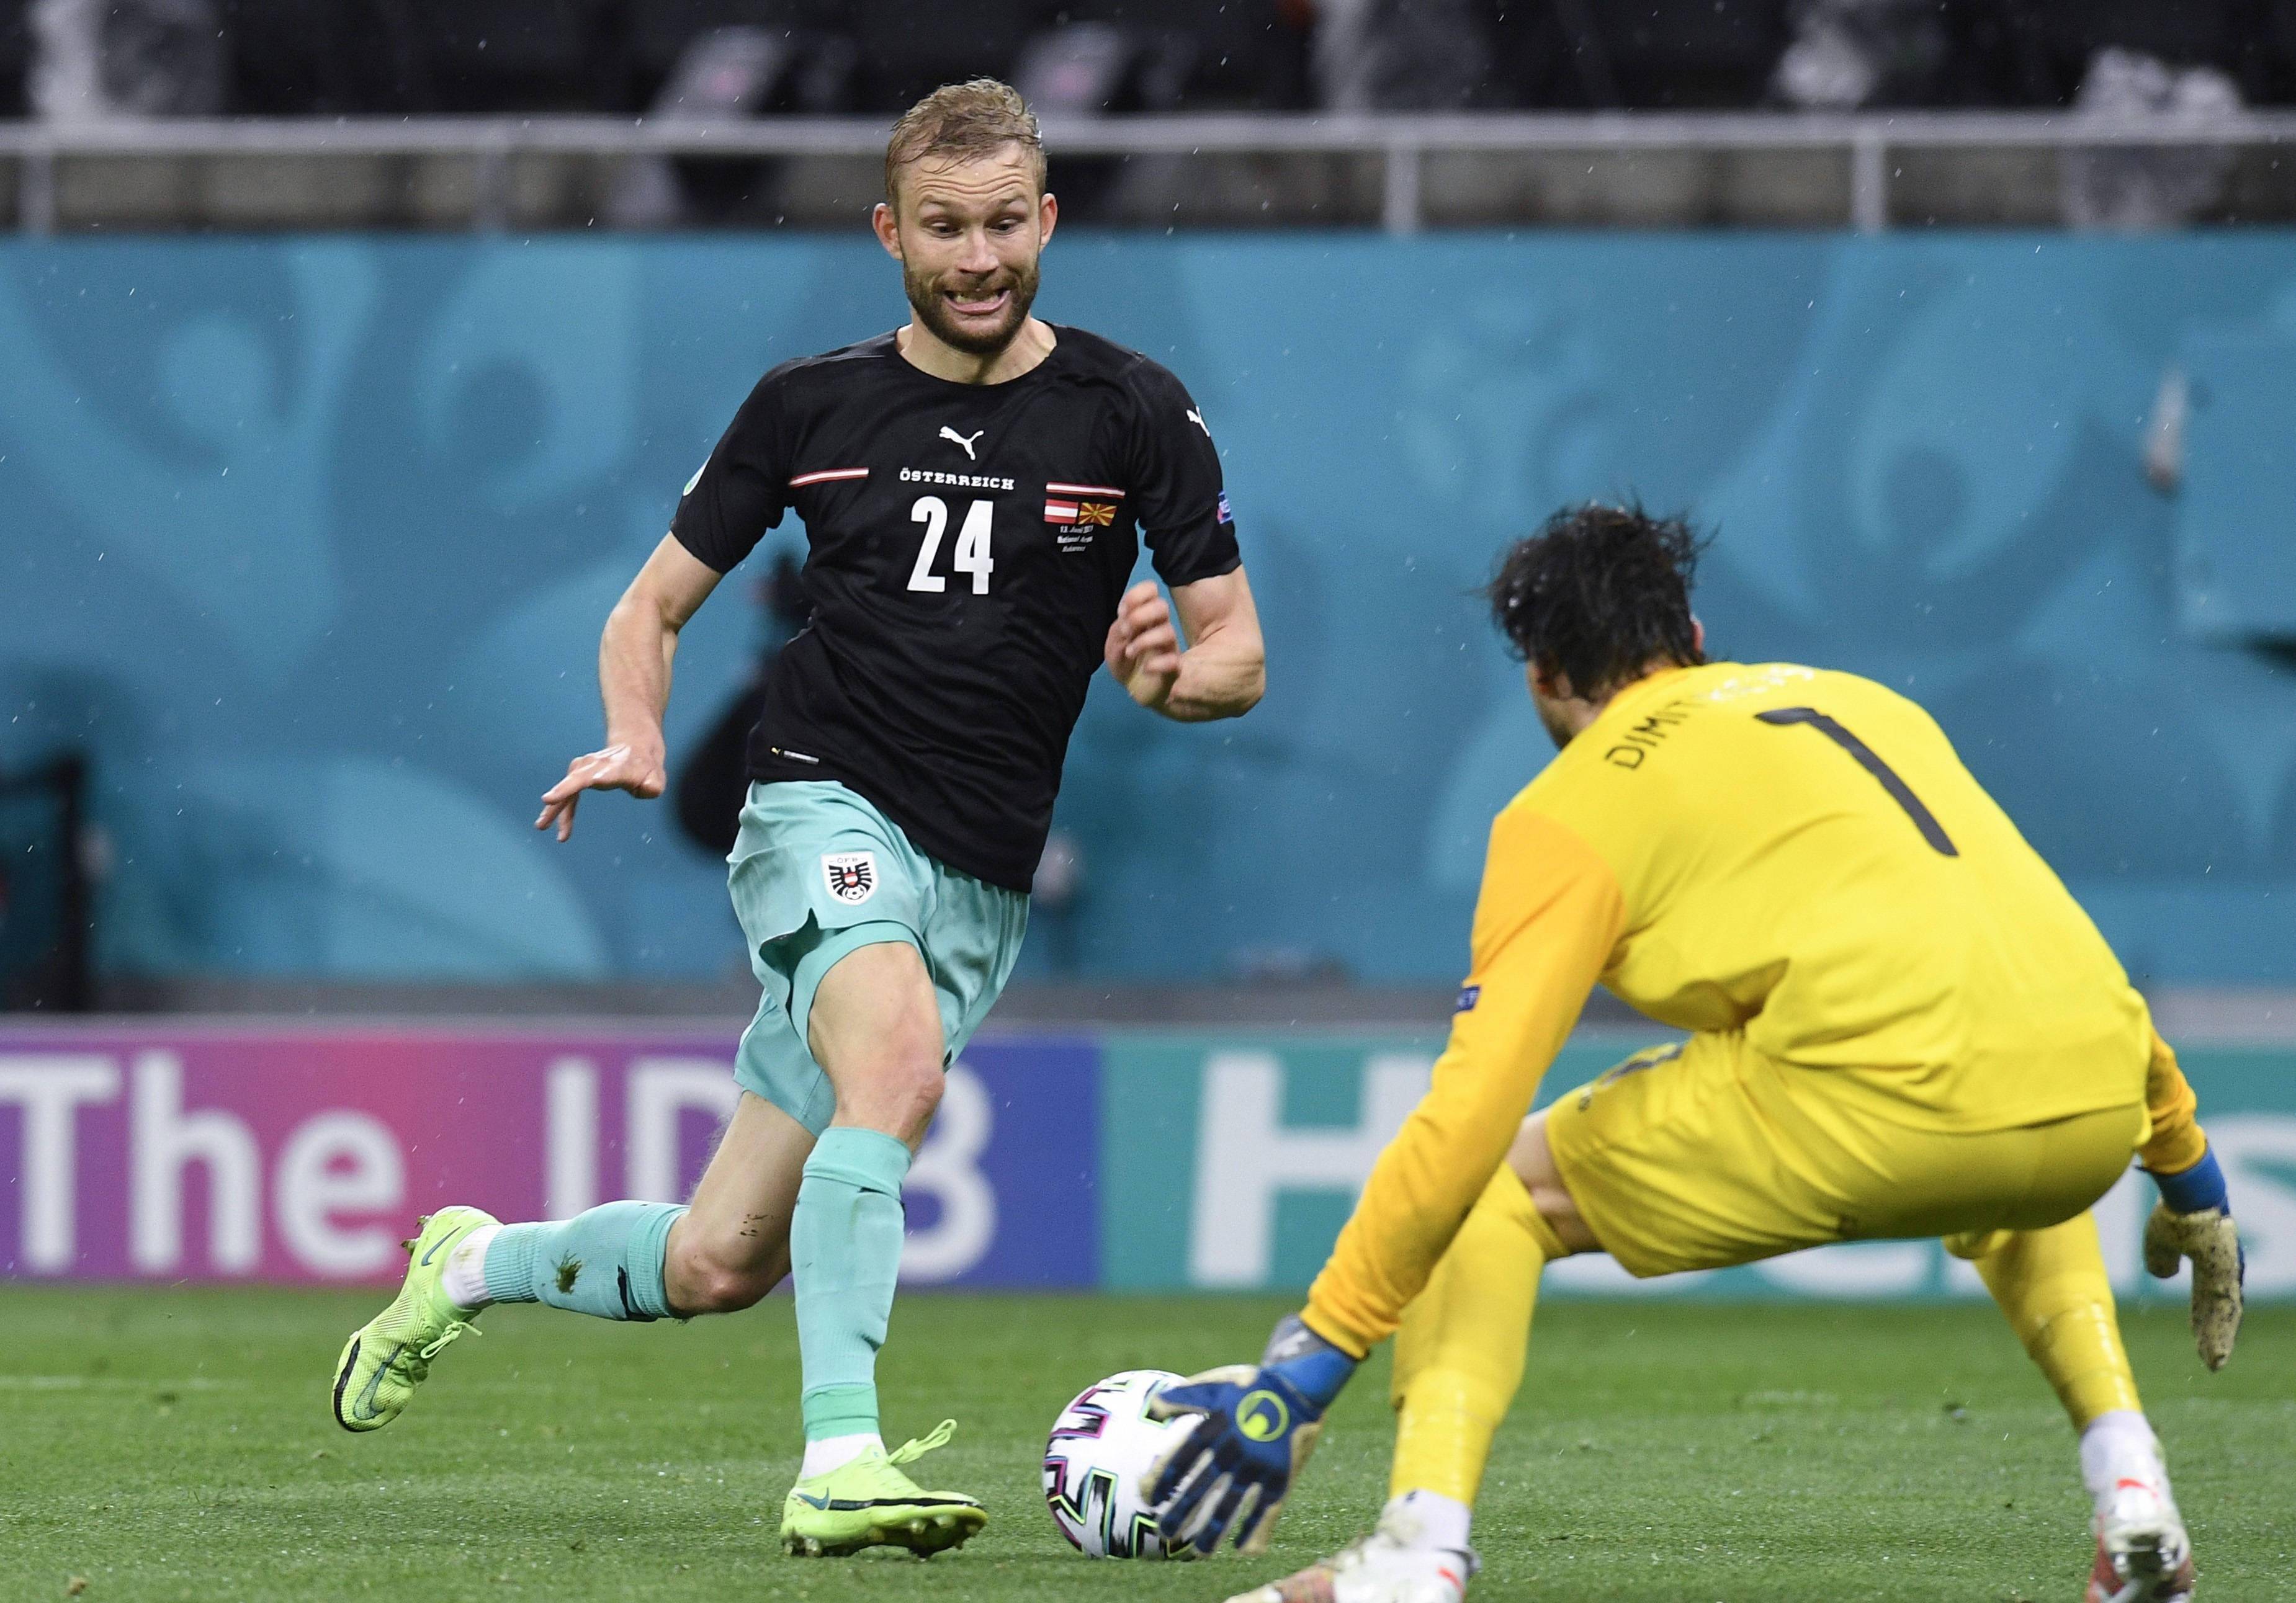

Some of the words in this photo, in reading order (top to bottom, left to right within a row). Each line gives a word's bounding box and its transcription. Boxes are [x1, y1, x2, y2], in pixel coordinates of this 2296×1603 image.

[899, 467, 1015, 490] ÖSTERREICH
[907, 496, 994, 595] 24
[1753, 707, 1960, 857] 1
[0, 1048, 407, 1278] The
